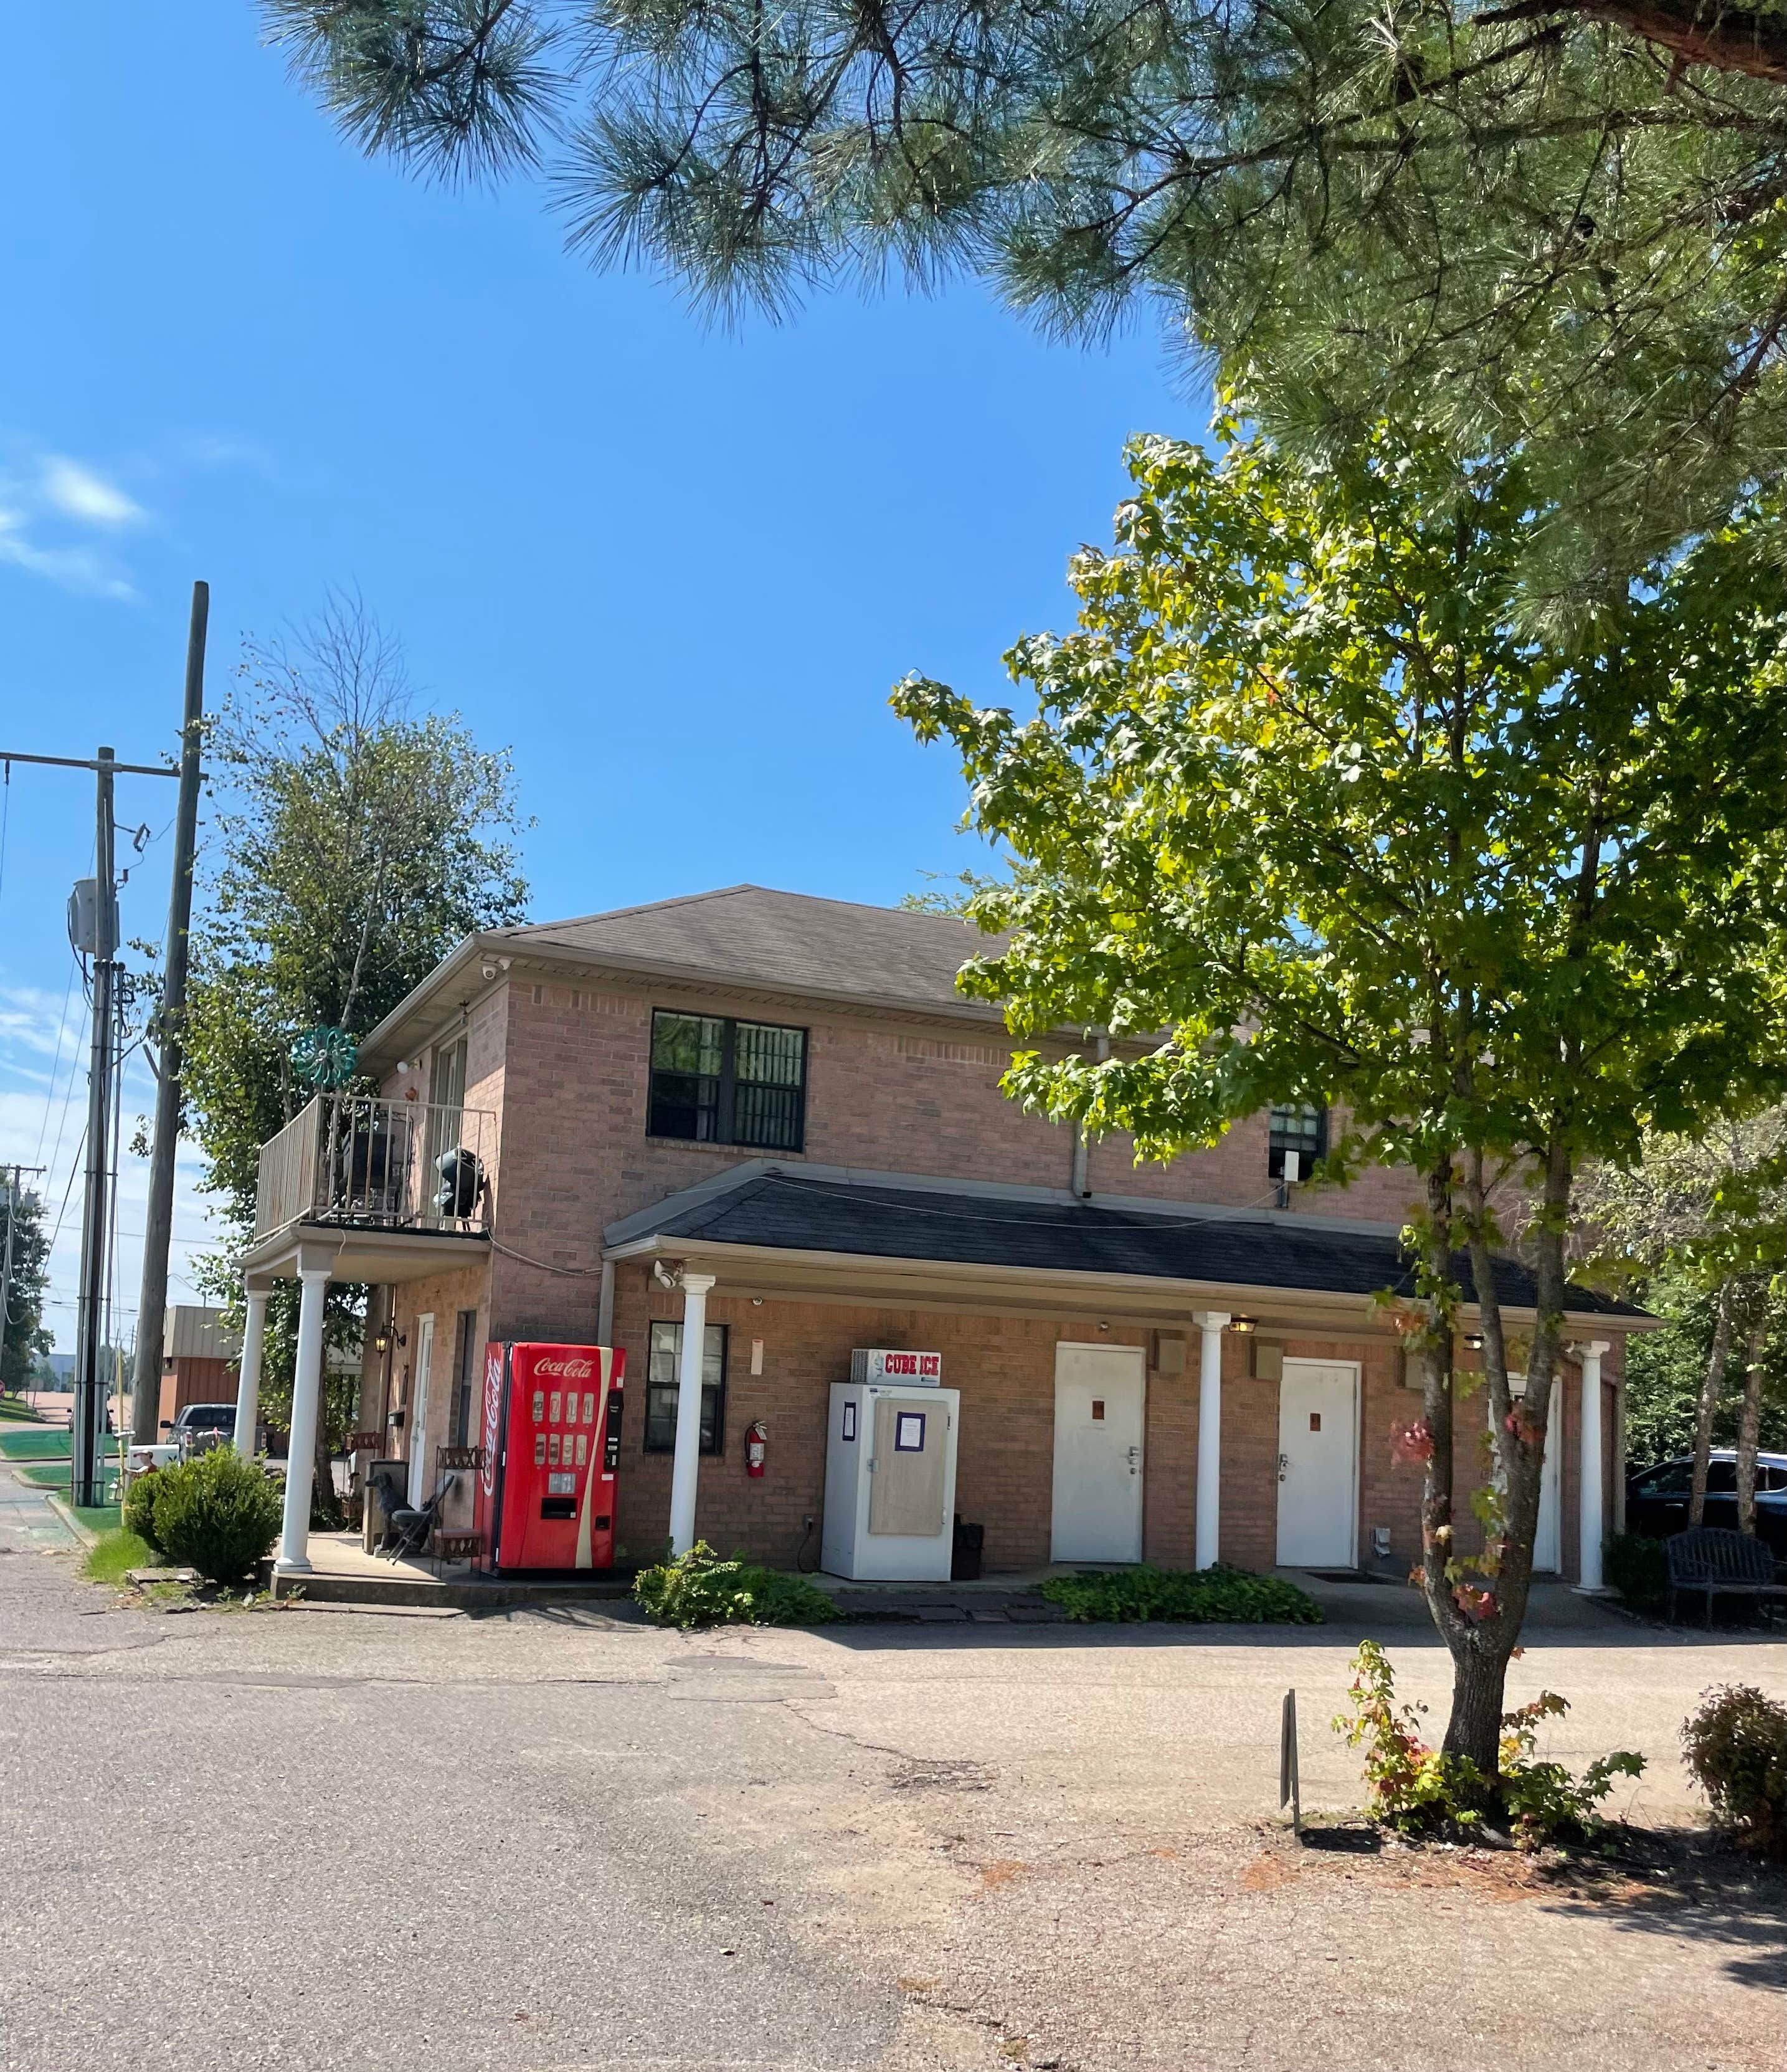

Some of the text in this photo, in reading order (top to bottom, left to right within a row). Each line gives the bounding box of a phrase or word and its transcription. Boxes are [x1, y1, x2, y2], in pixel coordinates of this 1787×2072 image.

[533, 1357, 595, 1378] Coca-Cola
[885, 1354, 939, 1376] CUBE ICE
[480, 1350, 501, 1496] Coca-Cola
